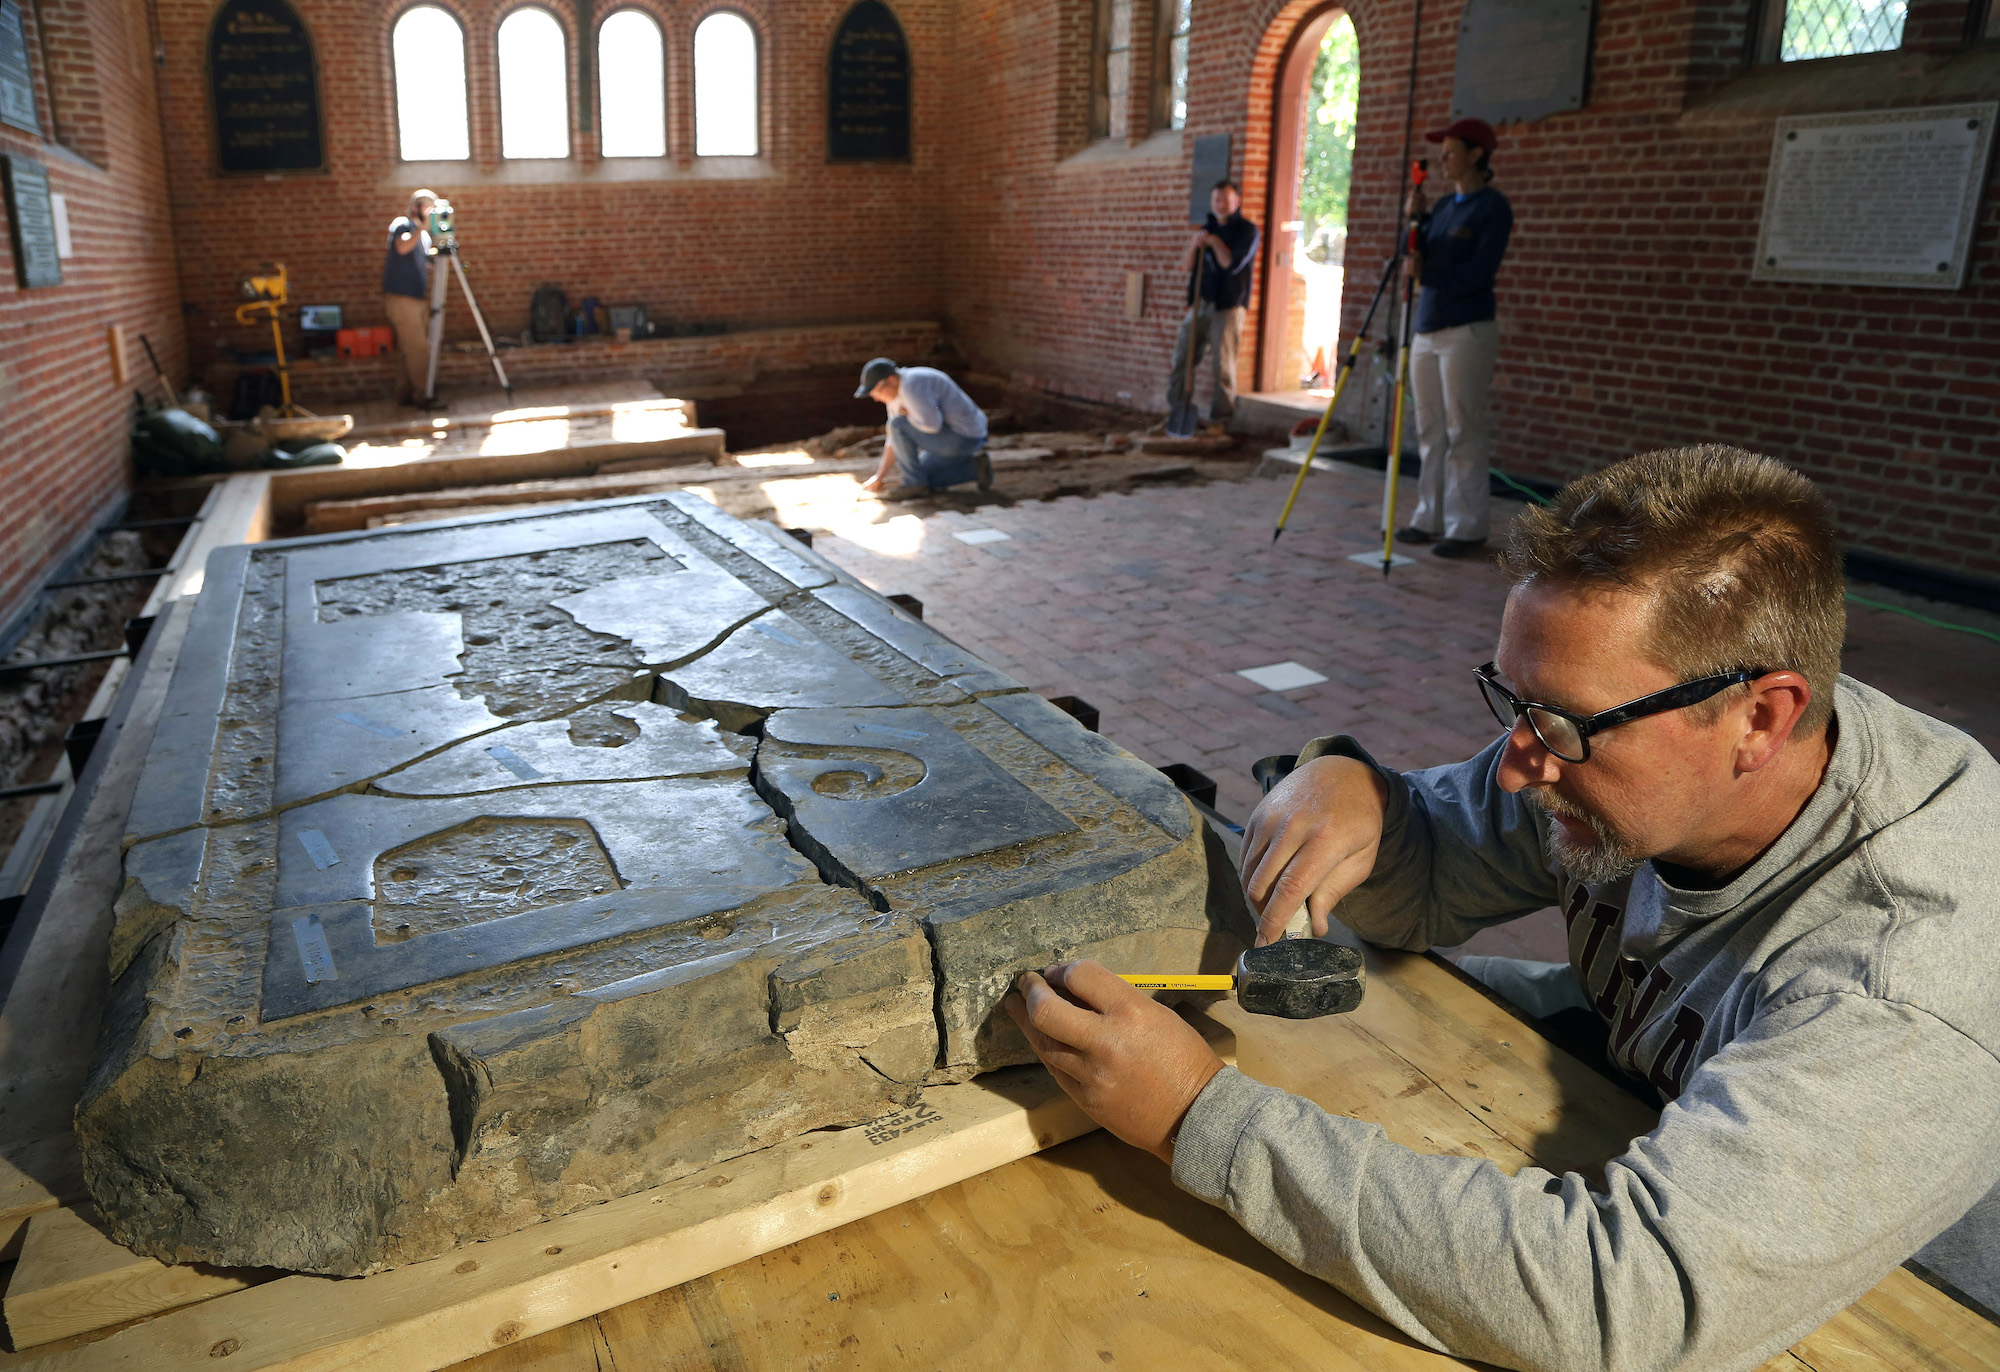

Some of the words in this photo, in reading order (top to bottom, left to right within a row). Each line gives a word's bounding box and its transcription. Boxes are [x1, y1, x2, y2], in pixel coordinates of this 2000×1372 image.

[909, 1102, 937, 1119] 2
[864, 1114, 912, 1137] KD-HT
[867, 1129, 900, 1146] 433
